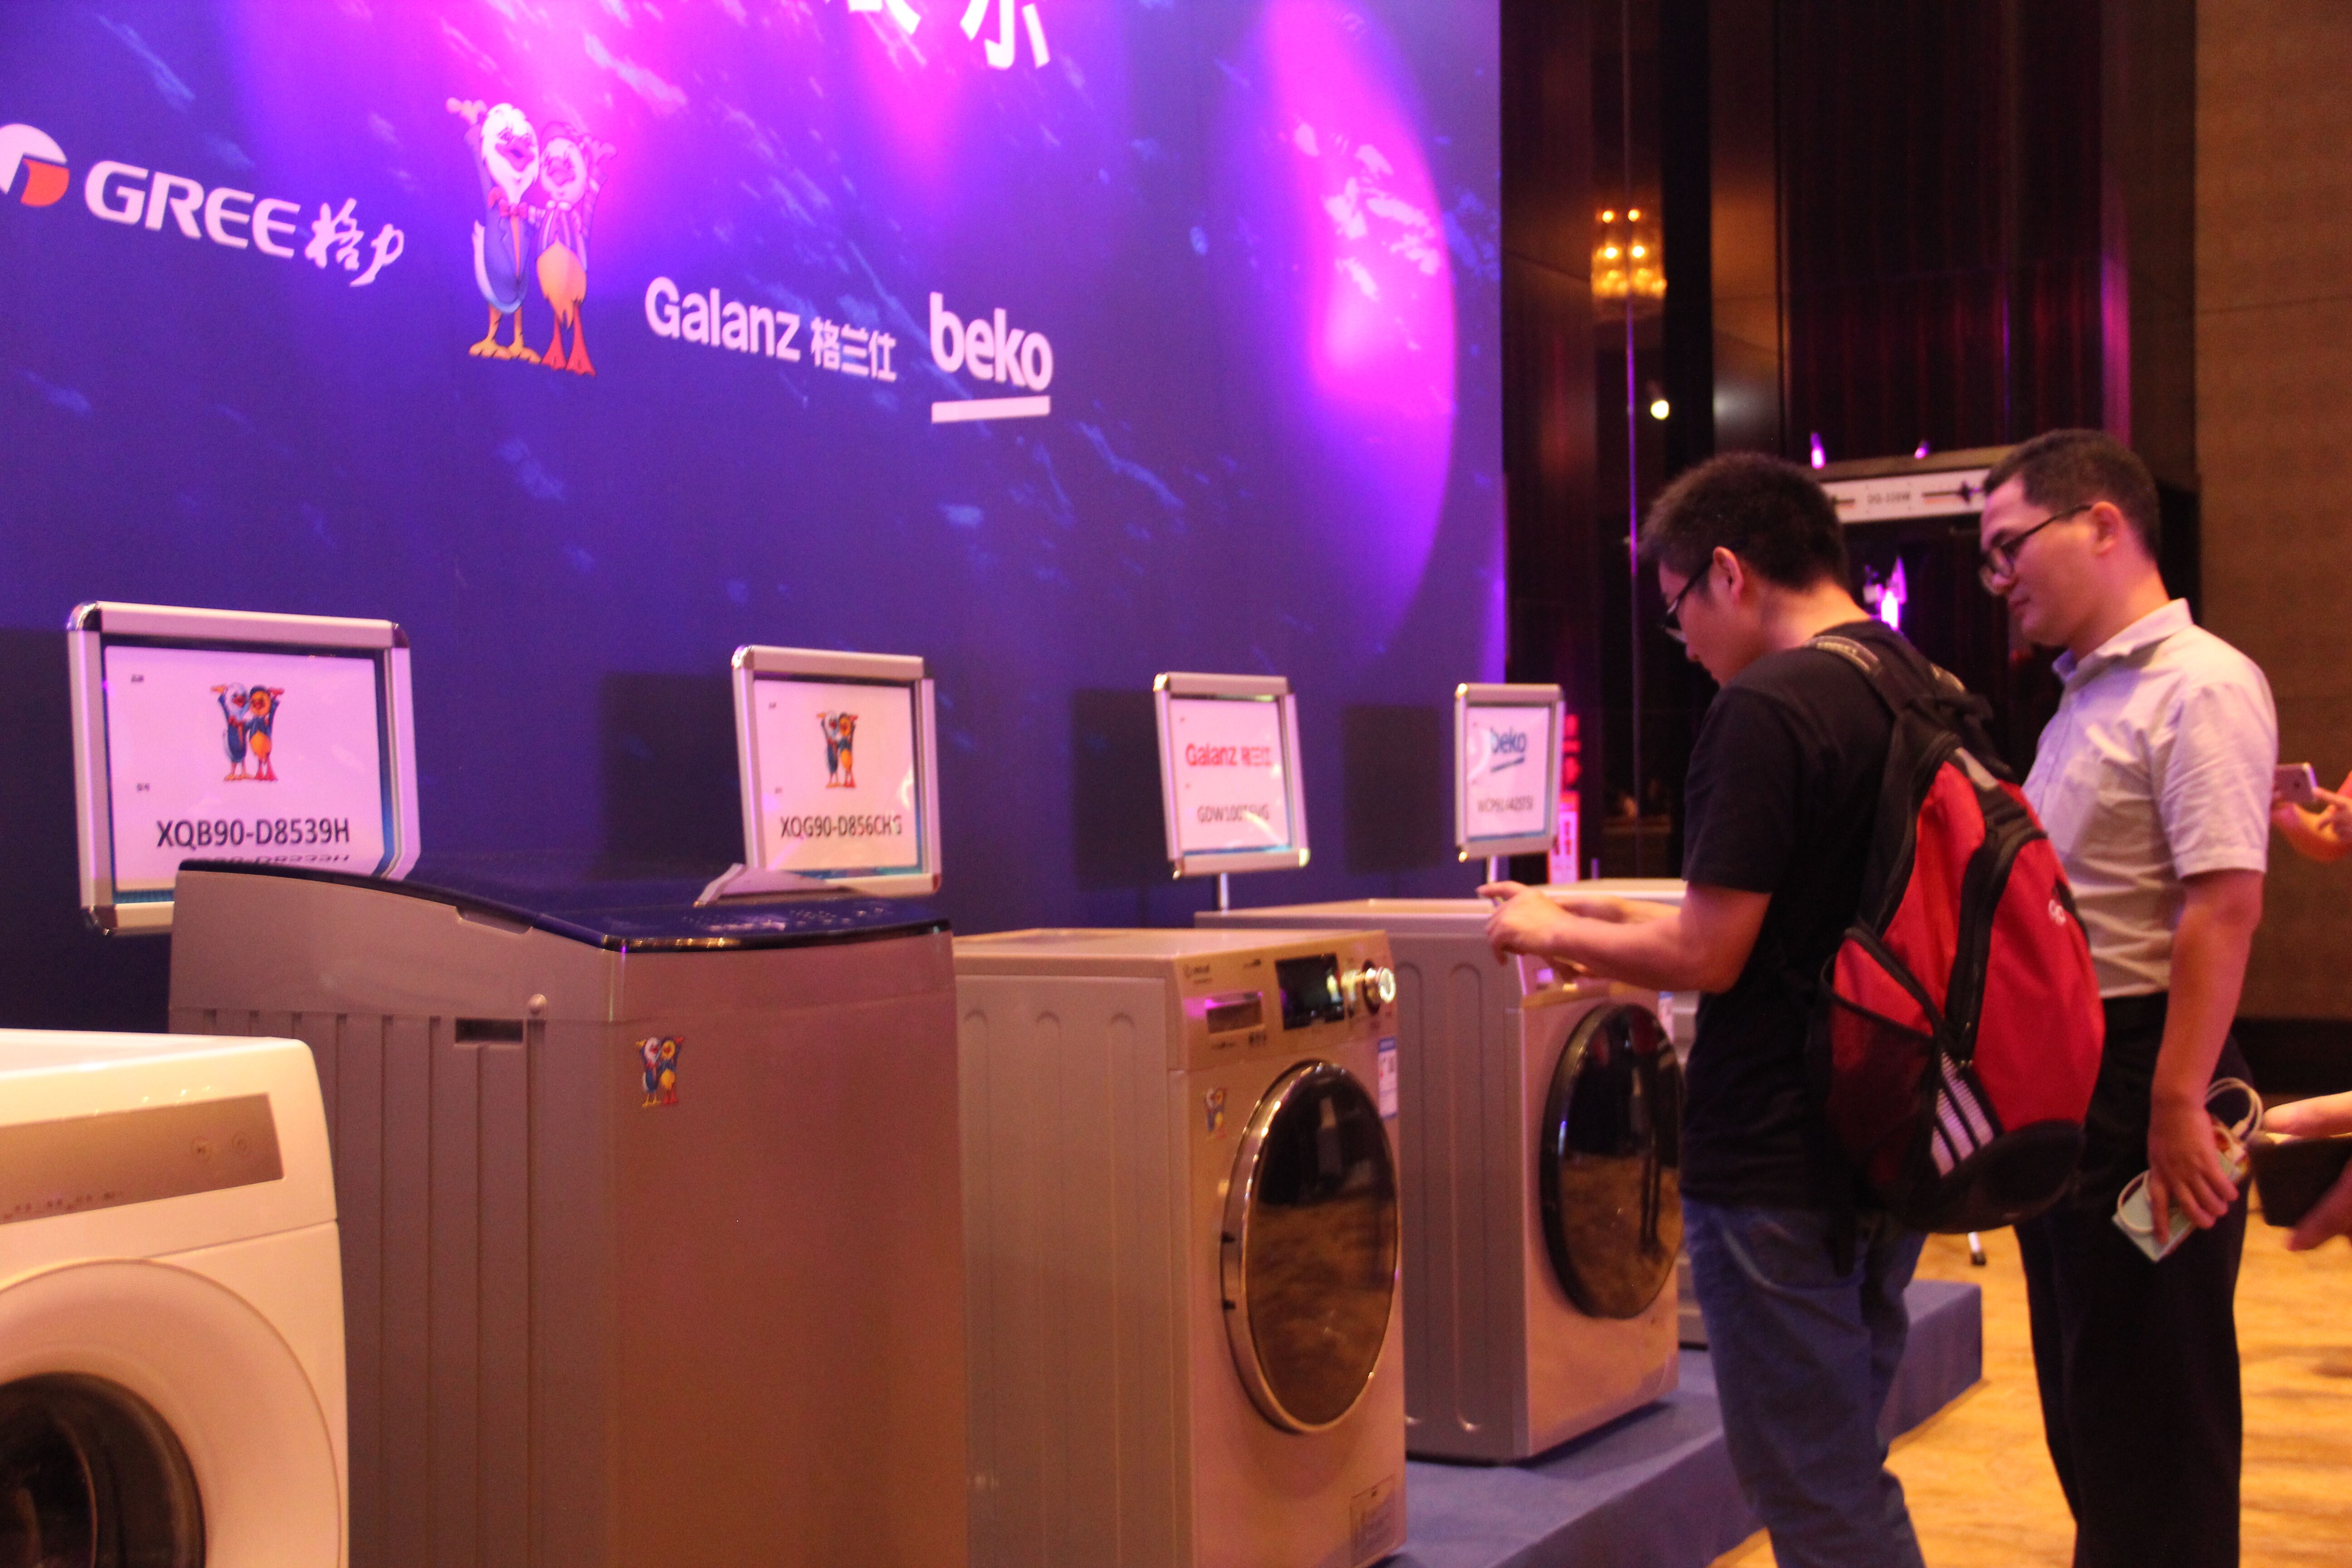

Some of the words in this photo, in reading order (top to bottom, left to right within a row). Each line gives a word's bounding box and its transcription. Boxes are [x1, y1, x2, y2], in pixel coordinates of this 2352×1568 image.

[84, 160, 301, 258] GREE
[645, 276, 801, 362] Galanz
[811, 316, 897, 382] 格兰仕
[930, 292, 1054, 391] beko
[1186, 743, 1238, 767] Galanz
[157, 818, 349, 850] XQB90-D8539H
